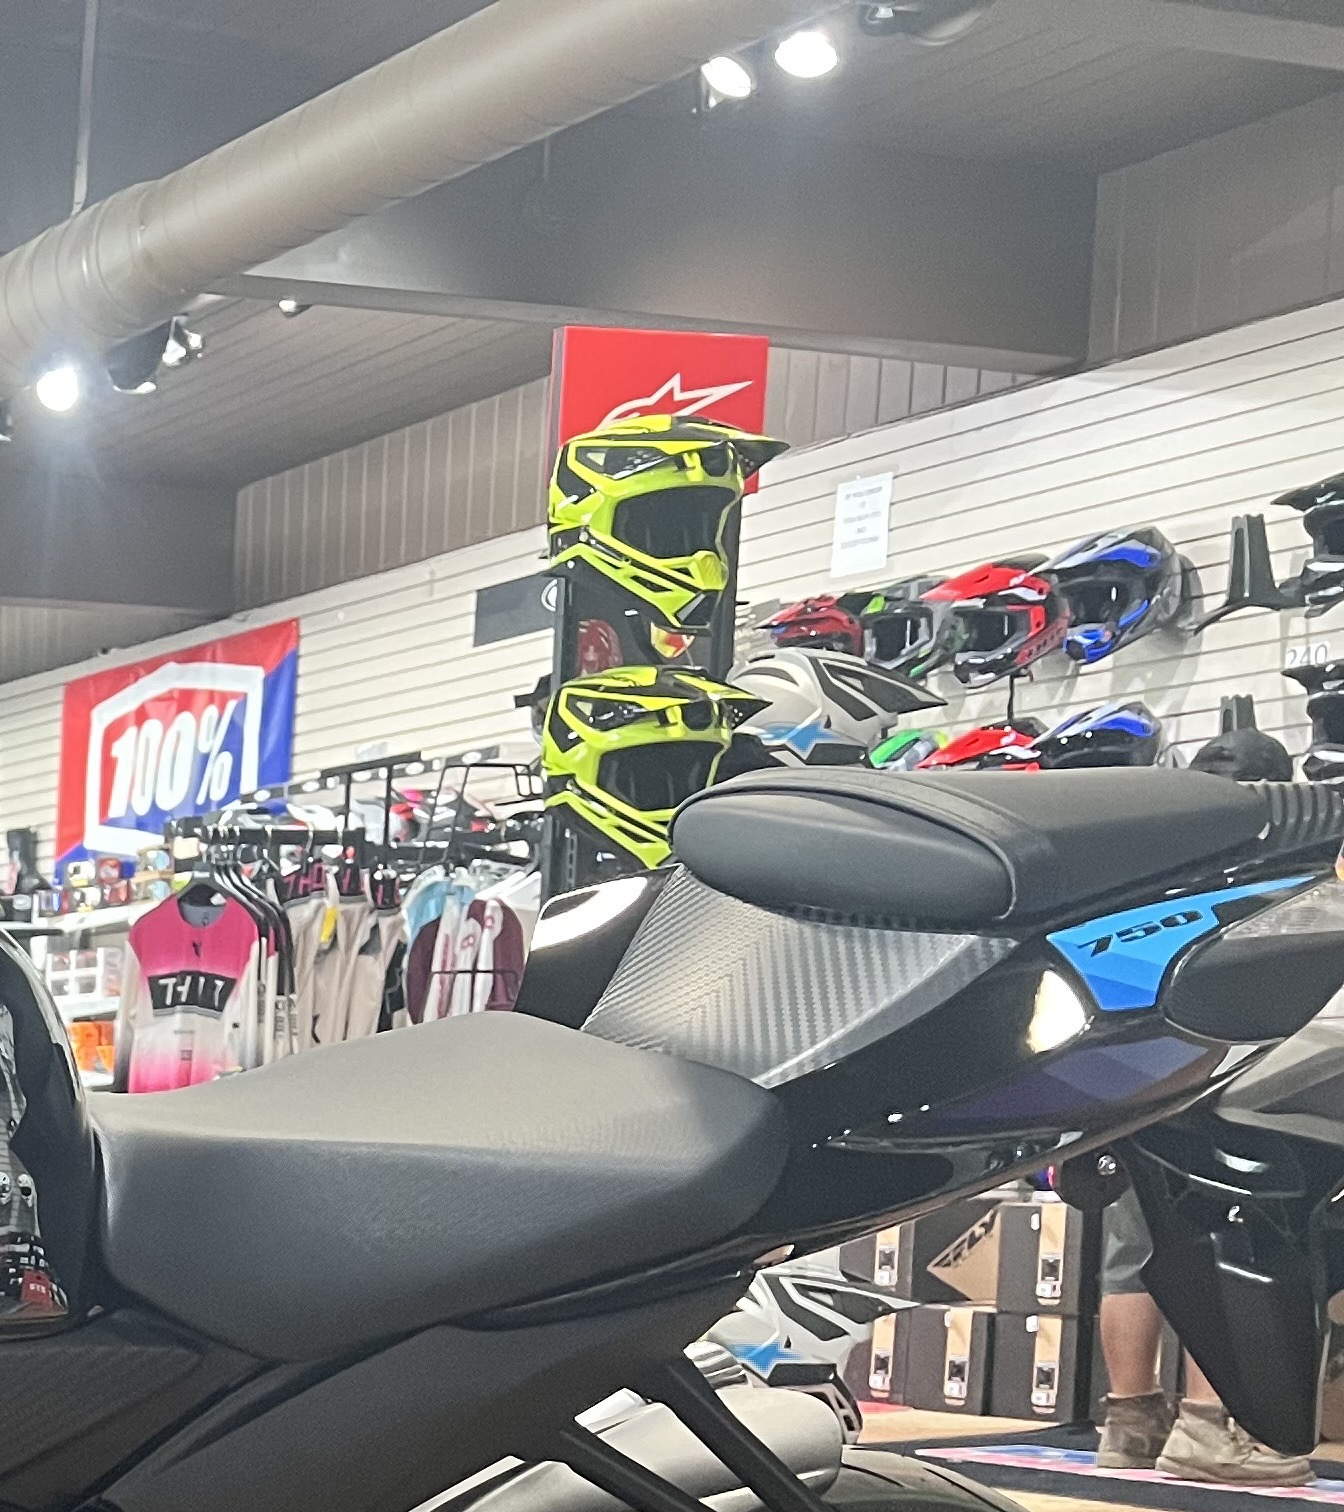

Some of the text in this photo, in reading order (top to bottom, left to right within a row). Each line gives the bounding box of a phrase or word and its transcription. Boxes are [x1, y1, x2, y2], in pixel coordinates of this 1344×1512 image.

[1285, 643, 1328, 667] 240
[108, 700, 239, 818] 100%
[1077, 910, 1204, 957] 750
